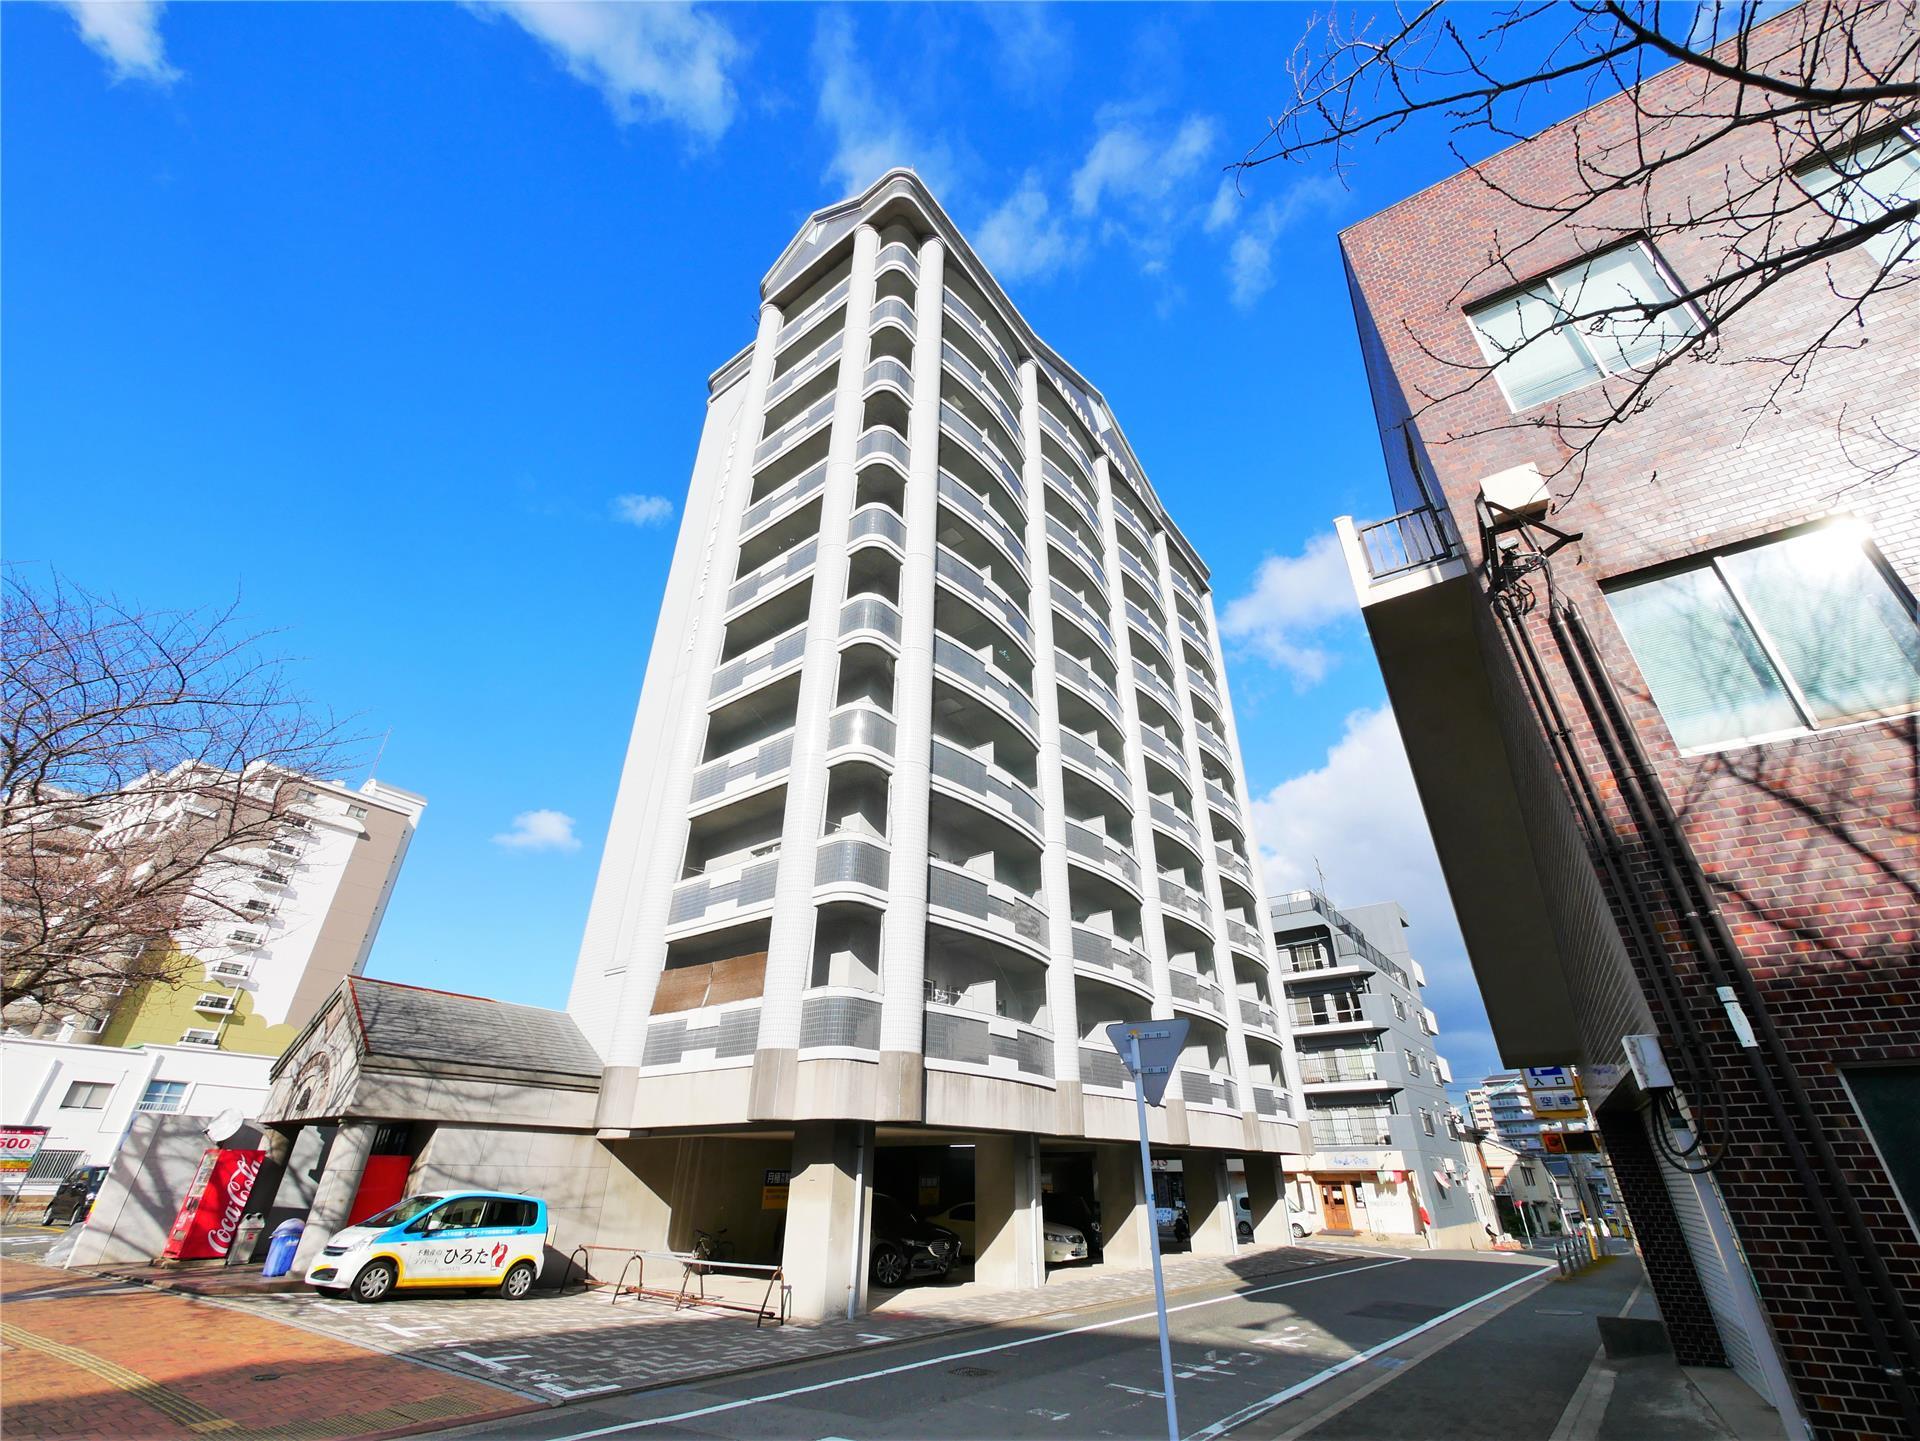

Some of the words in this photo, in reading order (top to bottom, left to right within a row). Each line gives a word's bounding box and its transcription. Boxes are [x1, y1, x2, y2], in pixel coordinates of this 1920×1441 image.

[1533, 1076, 1566, 1087] 入口
[1540, 1094, 1573, 1107] 空車
[443, 1247, 489, 1265] ひろた
